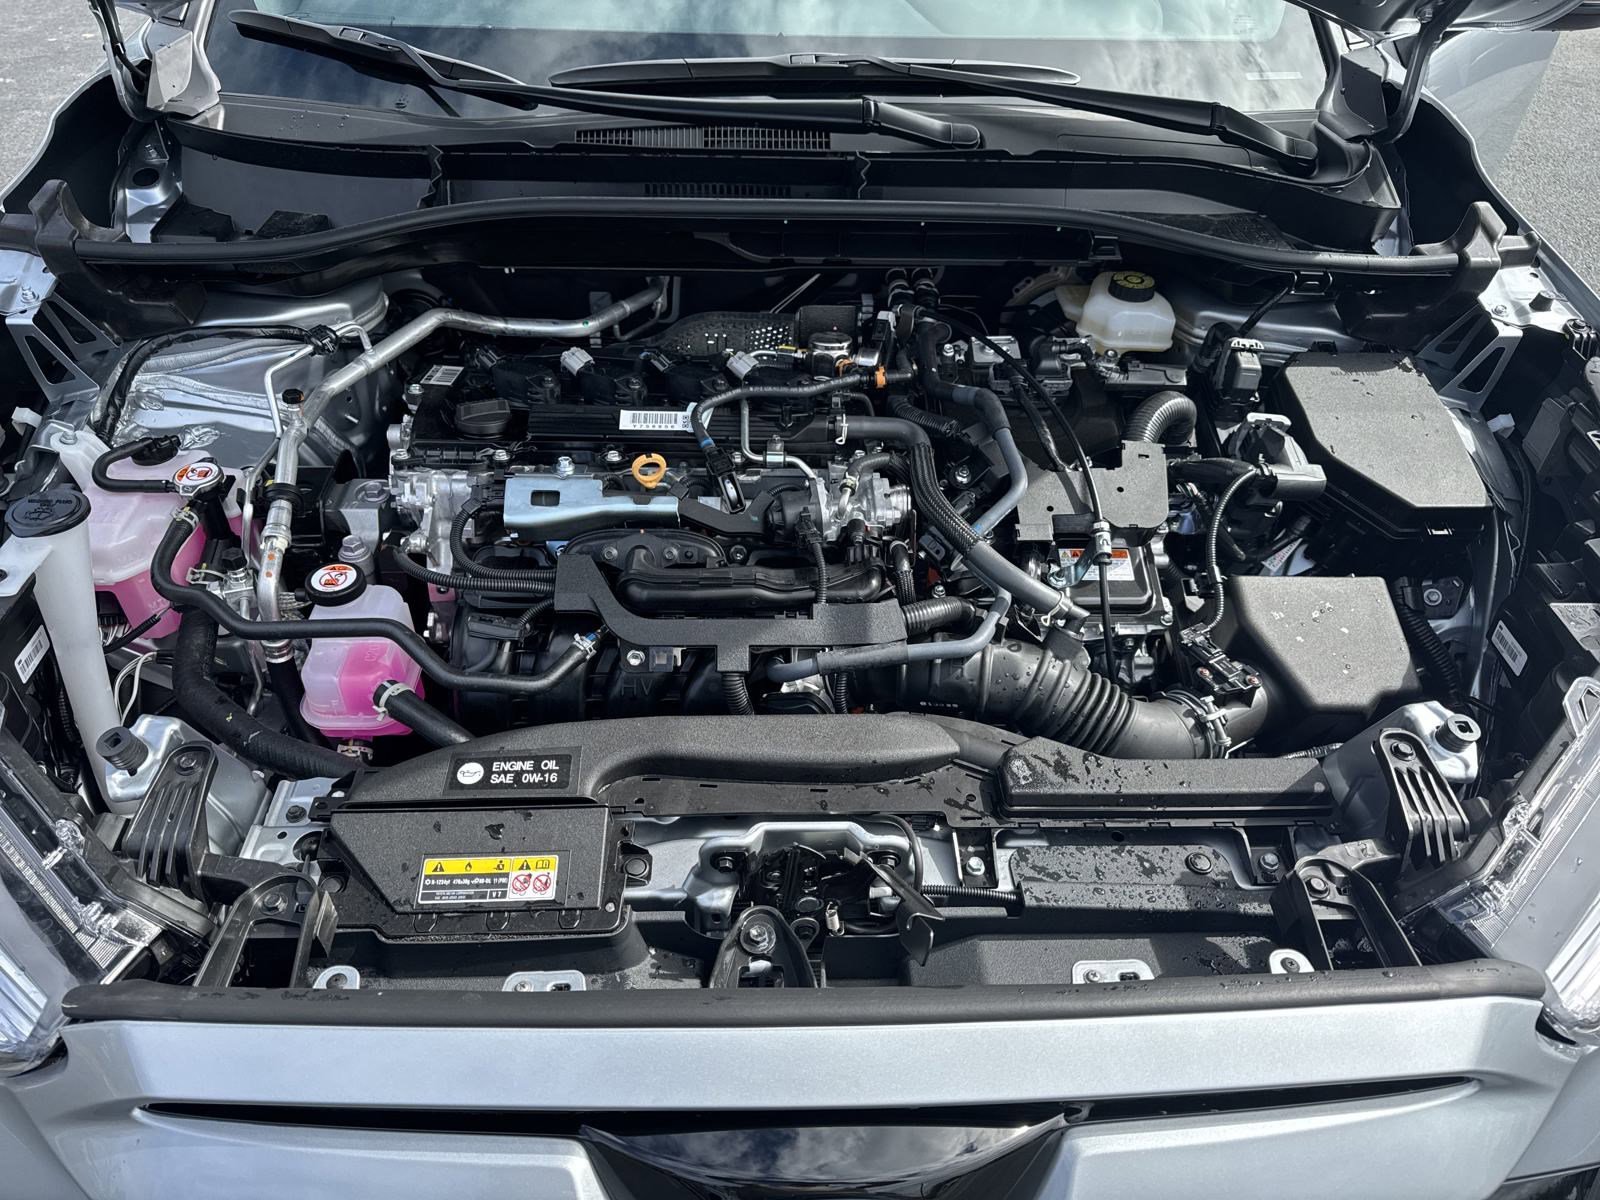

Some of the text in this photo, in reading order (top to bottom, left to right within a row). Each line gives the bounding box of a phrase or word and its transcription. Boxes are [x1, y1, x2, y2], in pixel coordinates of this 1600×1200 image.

[620, 678, 654, 696] HV
[492, 760, 559, 771] ENGINE OIL
[490, 773, 558, 783] SAE 0W-16
